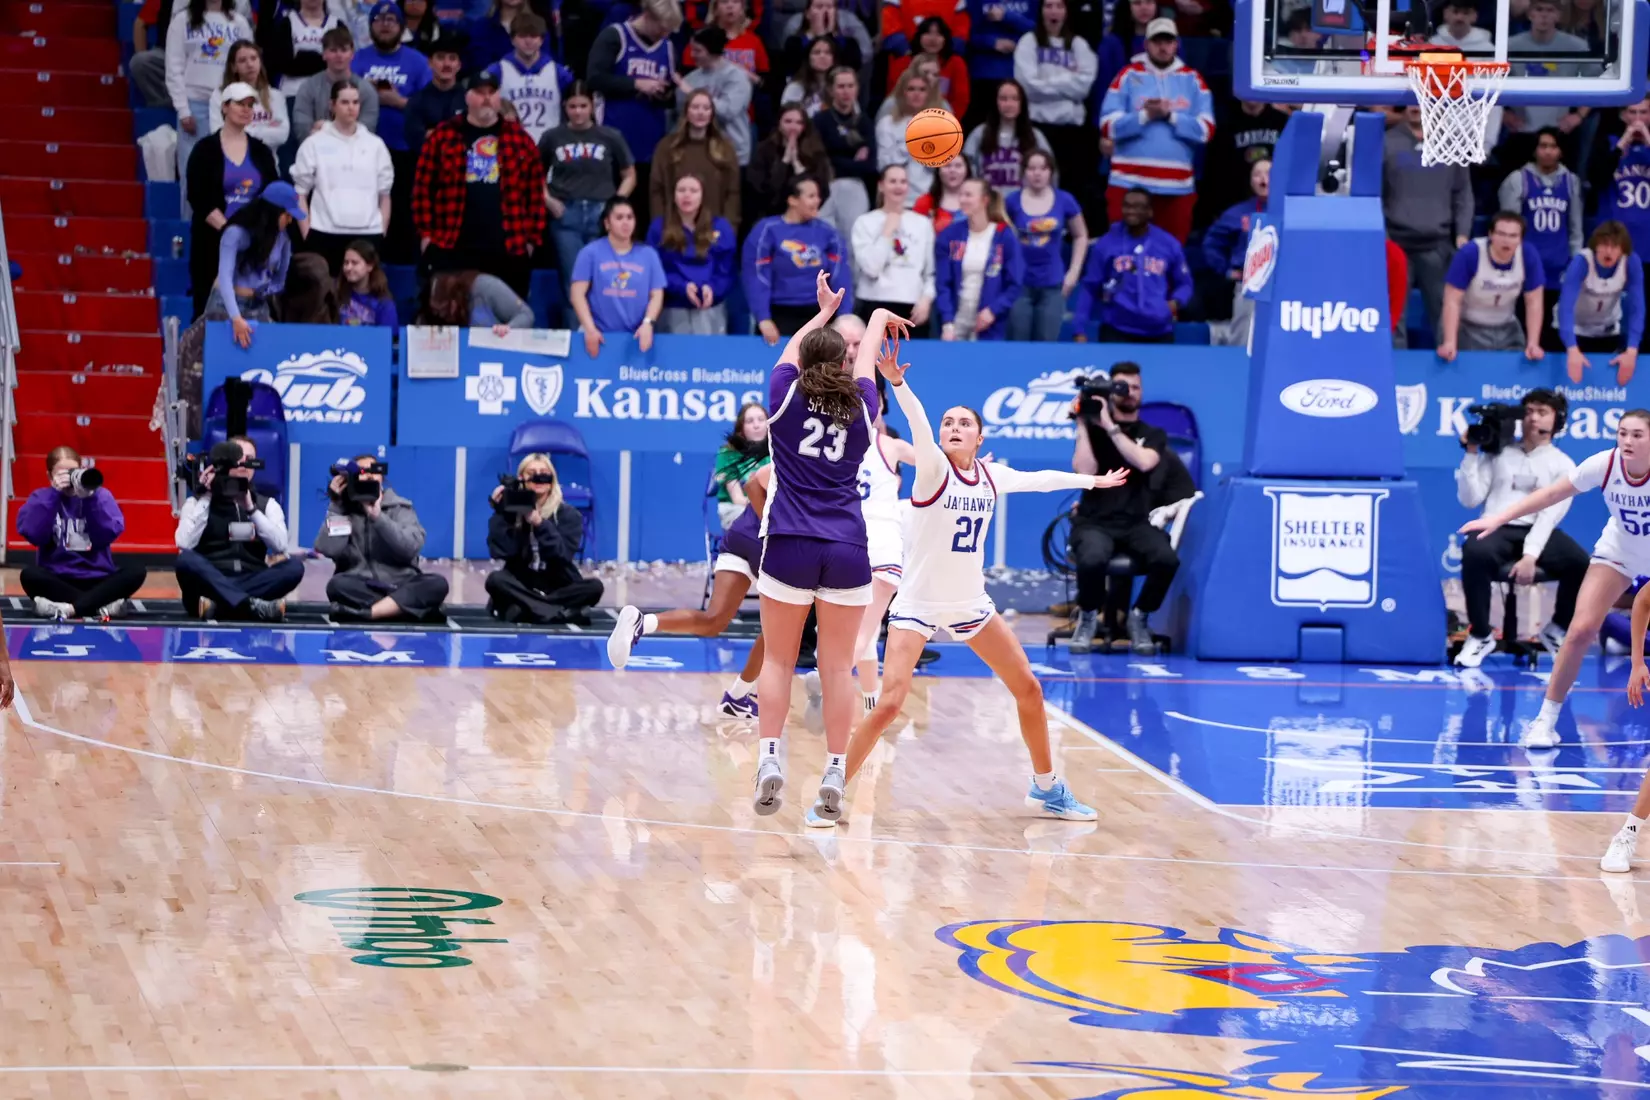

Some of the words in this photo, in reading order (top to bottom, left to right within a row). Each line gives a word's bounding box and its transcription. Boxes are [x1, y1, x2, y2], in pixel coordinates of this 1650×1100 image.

[1264, 78, 1299, 86] SPALDING
[508, 87, 553, 101] KANSAS
[518, 102, 546, 127] 22
[555, 142, 606, 162] STATE
[1617, 180, 1650, 209] 30
[1533, 209, 1561, 232] 00
[1280, 300, 1380, 339] HyVee
[619, 365, 688, 383] BlueCross
[692, 367, 765, 385] BlueShield
[1300, 386, 1357, 410] Ford
[1482, 383, 1524, 401] BlueCr
[982, 386, 1076, 426] Clu
[283, 409, 364, 424] WASH
[798, 416, 848, 463] 23
[980, 425, 1078, 440] CARWA
[674, 452, 682, 465] 4
[1609, 491, 1650, 508] JAYHAW
[951, 516, 984, 553] 21
[1283, 520, 1365, 536] SHELTER
[1283, 537, 1364, 549] INSURANCE
